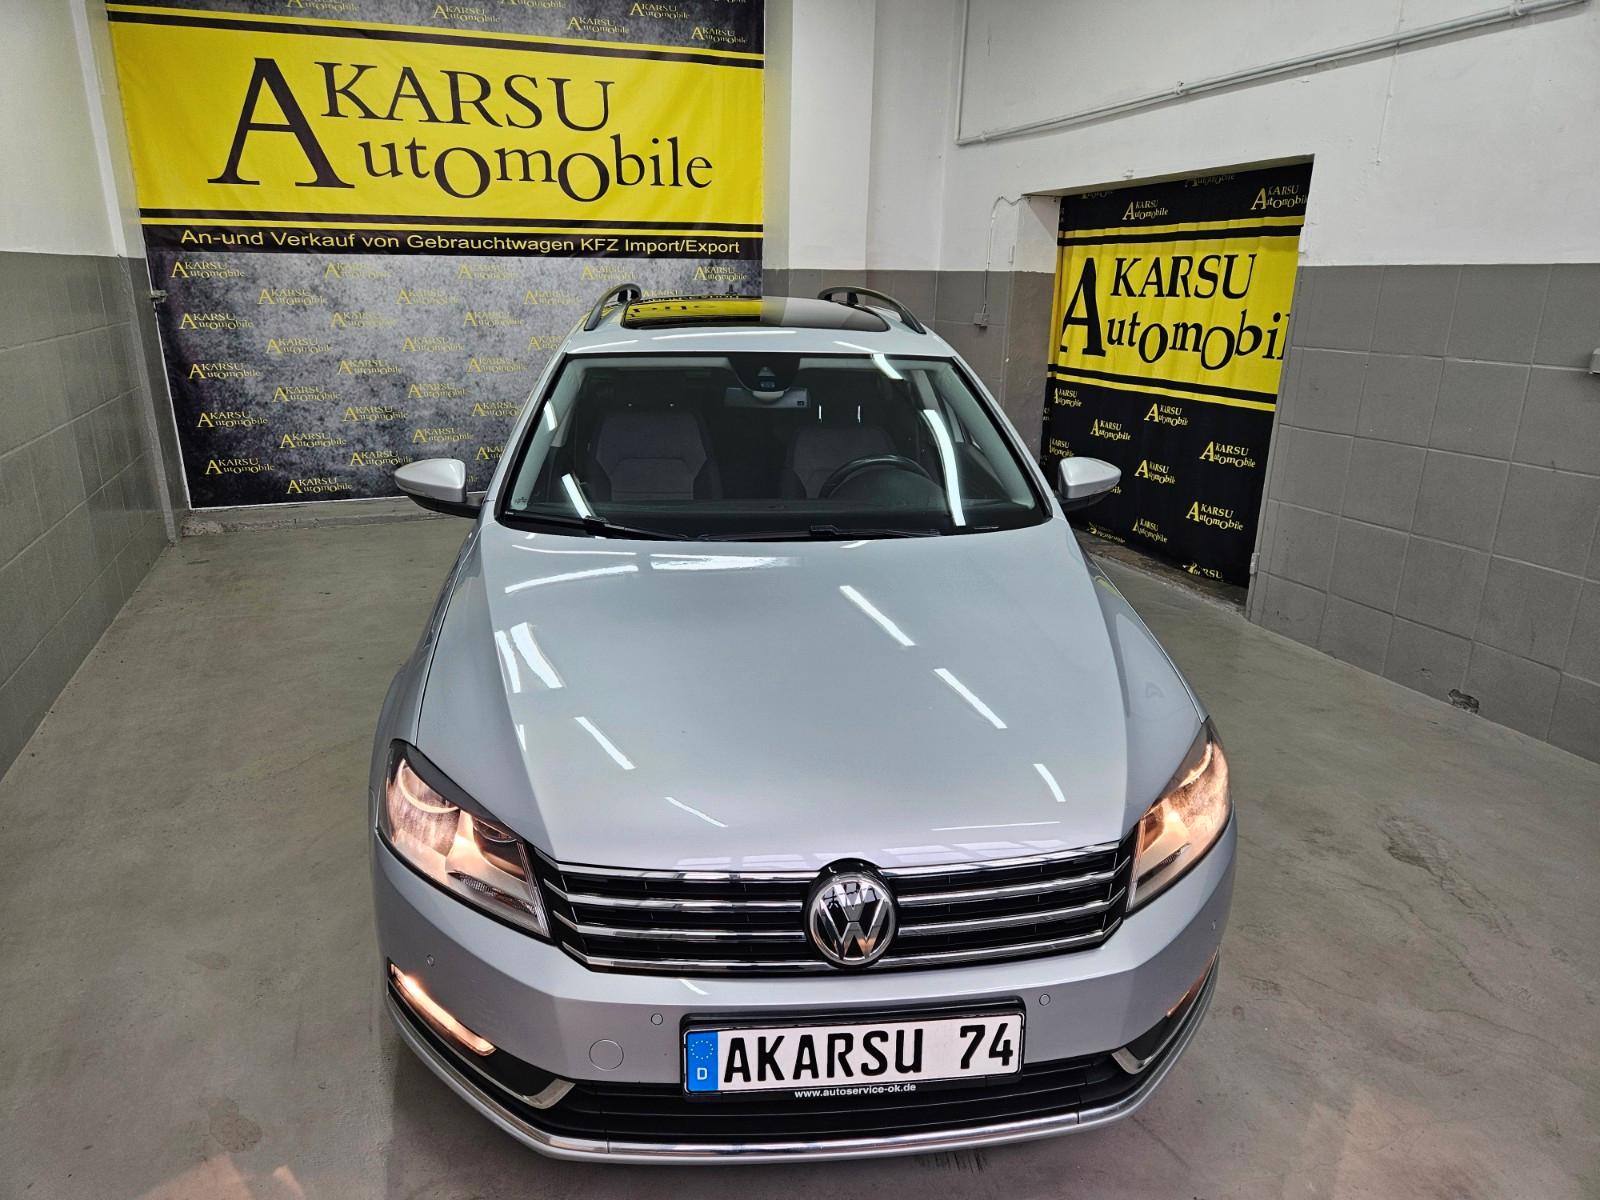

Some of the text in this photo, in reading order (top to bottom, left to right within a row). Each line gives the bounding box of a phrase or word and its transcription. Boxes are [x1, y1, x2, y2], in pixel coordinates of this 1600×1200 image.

[629, 3, 677, 17] AKARSU
[207, 57, 615, 188] AKARSU
[180, 229, 740, 255] An-und Verkauf von Gebrauchtwagen KFZ Import/Export
[170, 261, 227, 278] AKARSU
[1059, 253, 1257, 357] AKARSU
[178, 312, 235, 329] AKARSU
[188, 363, 243, 379] AKARSU
[196, 411, 250, 427] AKARSU
[1090, 418, 1122, 436] AKARSU
[279, 432, 330, 448] AKARSU
[349, 450, 398, 466] AKARSU
[1199, 441, 1249, 462] AKARSU
[204, 458, 258, 475] AKARSU
[285, 477, 336, 494] AKARSU
[1186, 501, 1234, 522] AKARSU
[724, 1022, 1014, 1083] AKARSU 74
[696, 1067, 708, 1081] D
[794, 1083, 917, 1099] www.autoservice-ok.de
